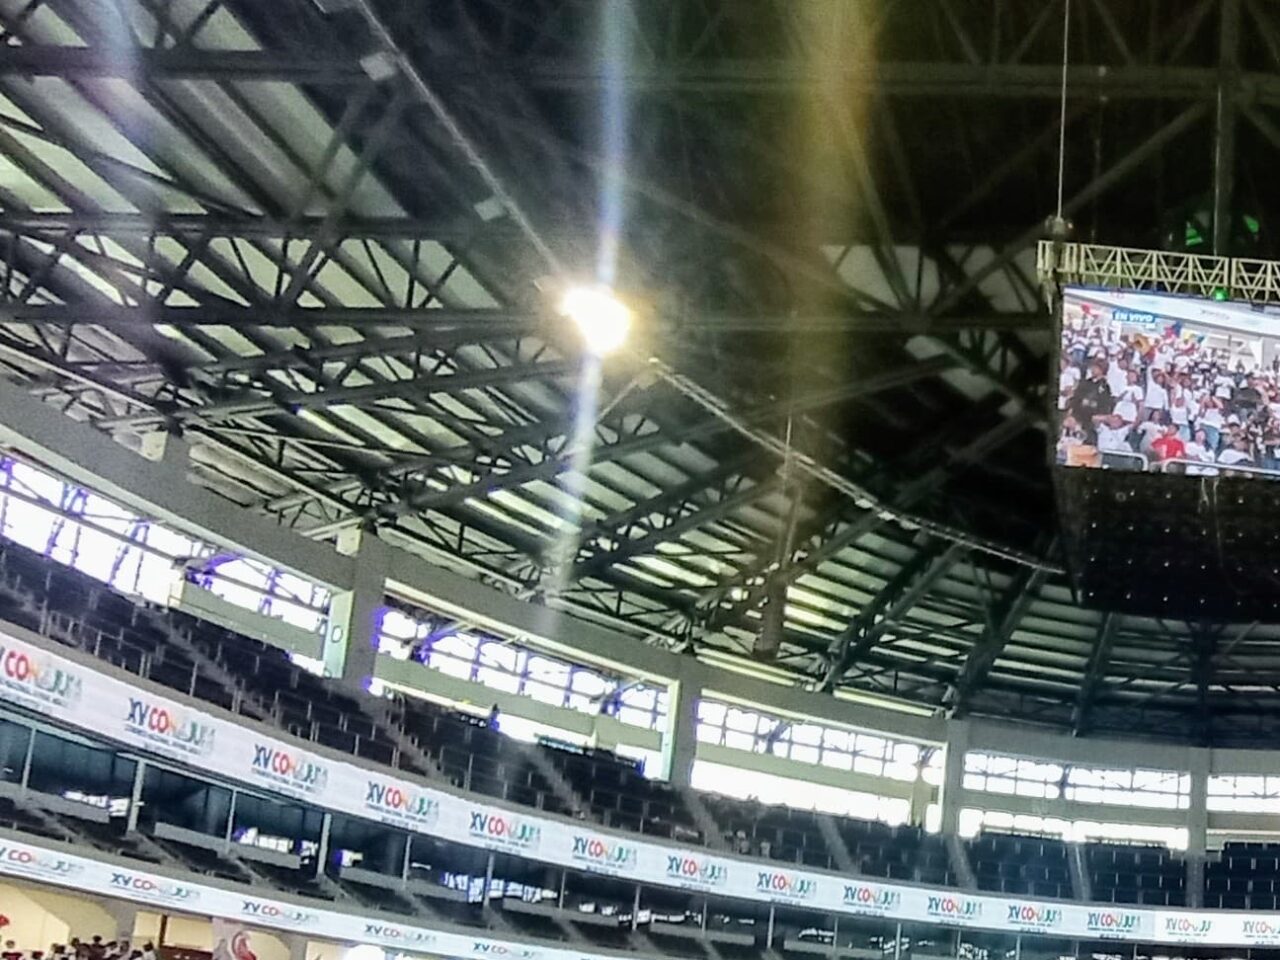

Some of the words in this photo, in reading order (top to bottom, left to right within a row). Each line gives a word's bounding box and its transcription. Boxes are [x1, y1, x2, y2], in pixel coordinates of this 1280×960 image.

[127, 697, 150, 726] XV
[252, 743, 271, 769] XV
[366, 780, 385, 803] XV
[470, 811, 488, 832] XV
[572, 836, 589, 855] XV
[667, 855, 683, 873] XV
[756, 872, 772, 889] XV
[843, 885, 858, 901] XV
[928, 896, 942, 911] XV
[1007, 905, 1021, 919] XV
[1087, 912, 1100, 928] XV
[1165, 917, 1178, 931] XV
[1243, 920, 1255, 933] XV
